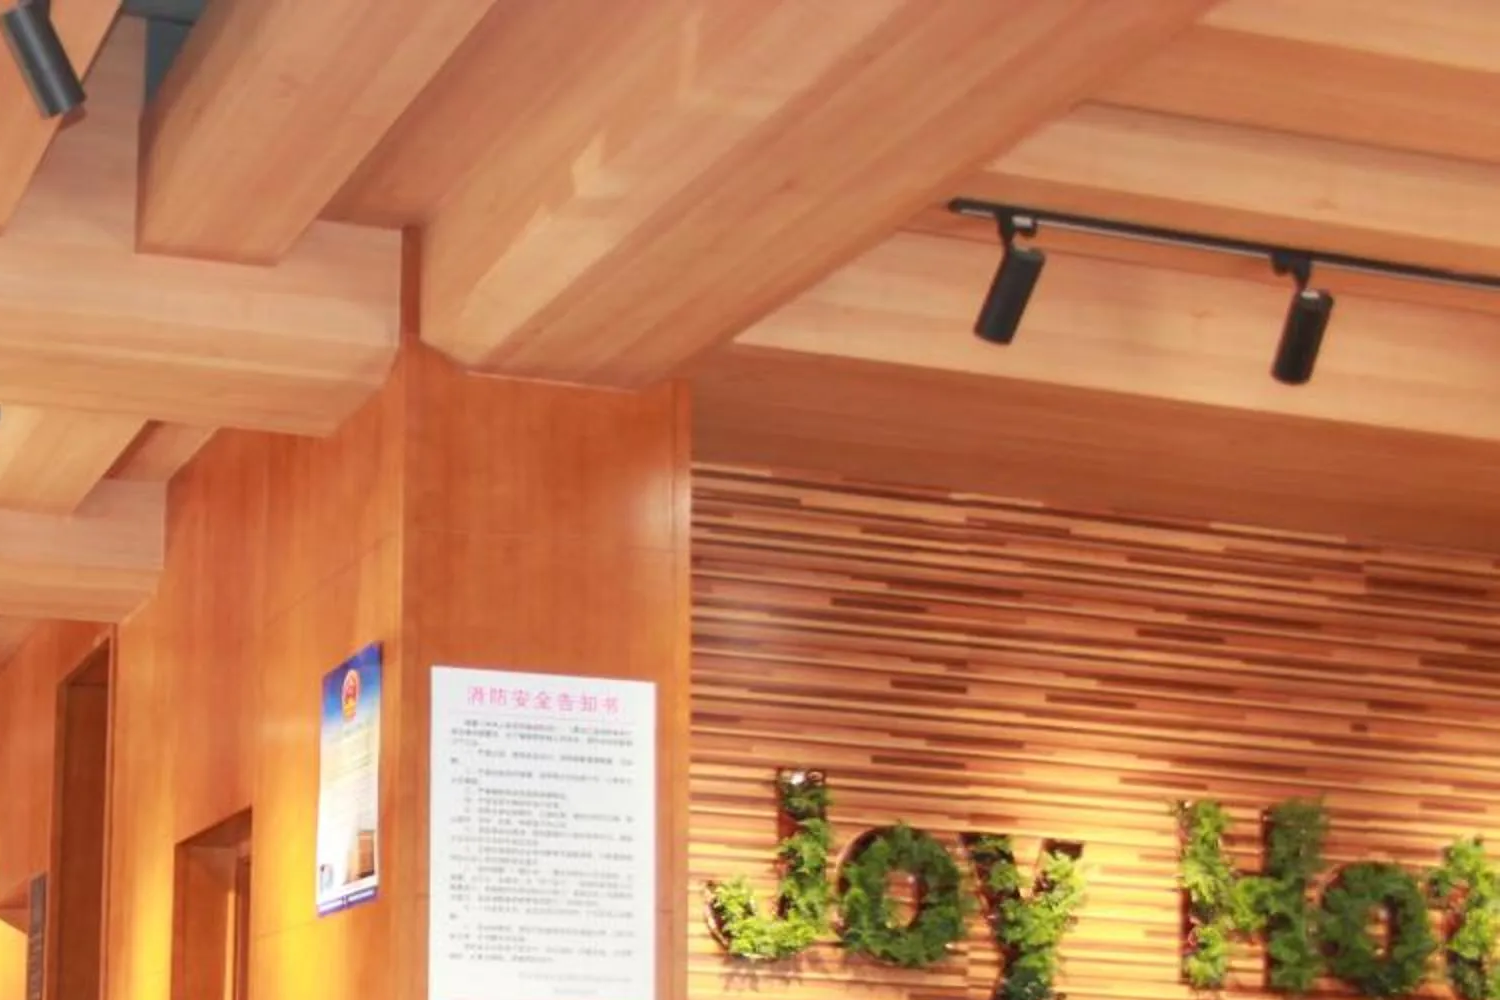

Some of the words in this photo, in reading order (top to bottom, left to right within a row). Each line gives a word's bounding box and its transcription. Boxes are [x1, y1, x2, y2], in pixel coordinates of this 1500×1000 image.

[466, 684, 621, 714] 消防安全告知书
